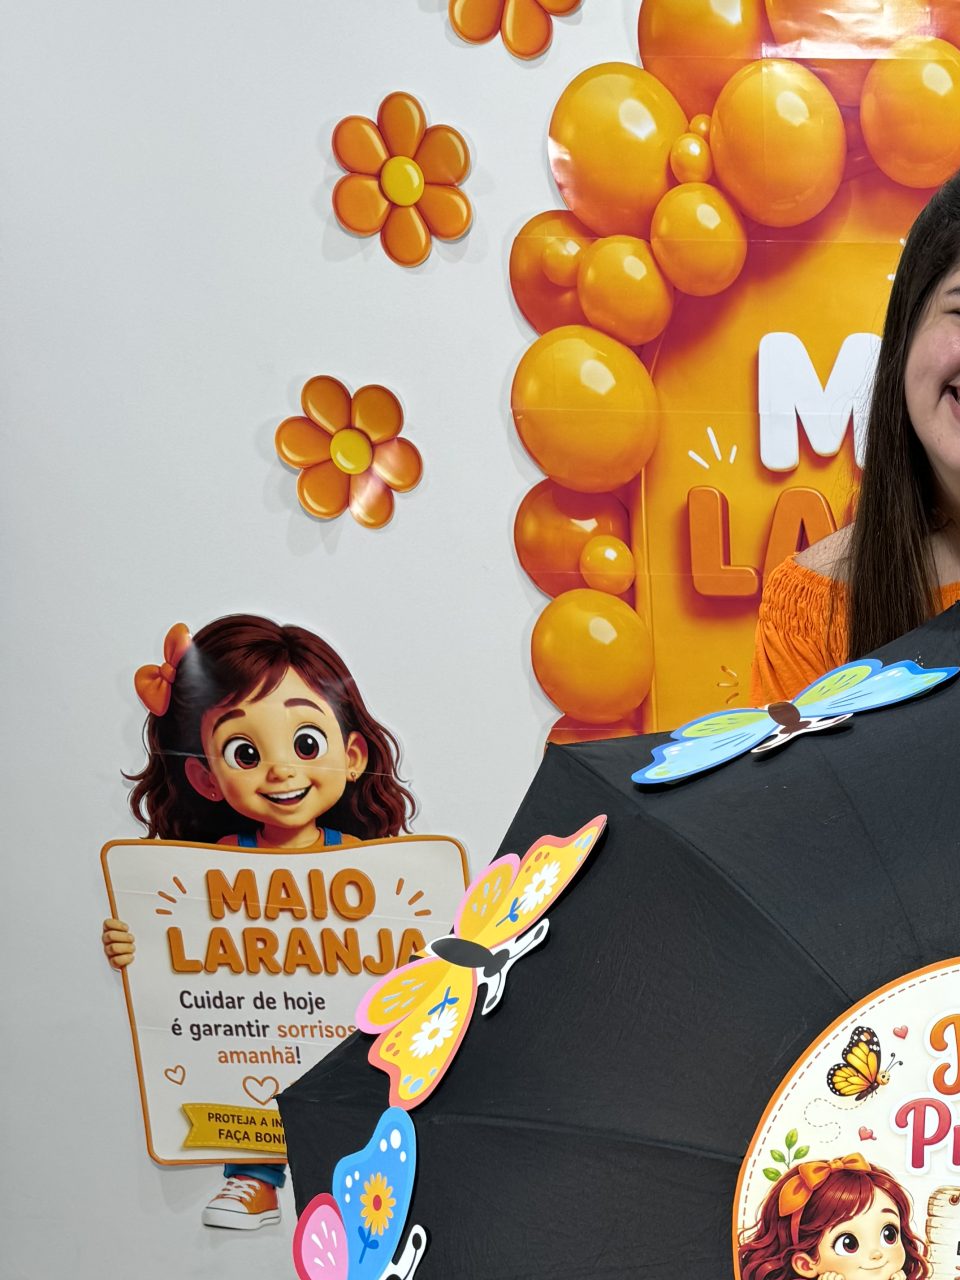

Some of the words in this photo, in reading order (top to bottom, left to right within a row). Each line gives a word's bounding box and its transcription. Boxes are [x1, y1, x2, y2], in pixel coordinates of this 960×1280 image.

[205, 868, 376, 920] MAIO
[179, 990, 245, 1010] Cuidar
[253, 991, 277, 1010] de
[284, 991, 326, 1015] hoje
[171, 1018, 182, 1036] é
[190, 1019, 270, 1041] garantir
[277, 1020, 357, 1039] sorrisos
[218, 1045, 302, 1065] amanhã!
[208, 1112, 257, 1126] PROTEJA
[260, 1116, 268, 1126] A
[218, 1128, 251, 1143] FAÇA
